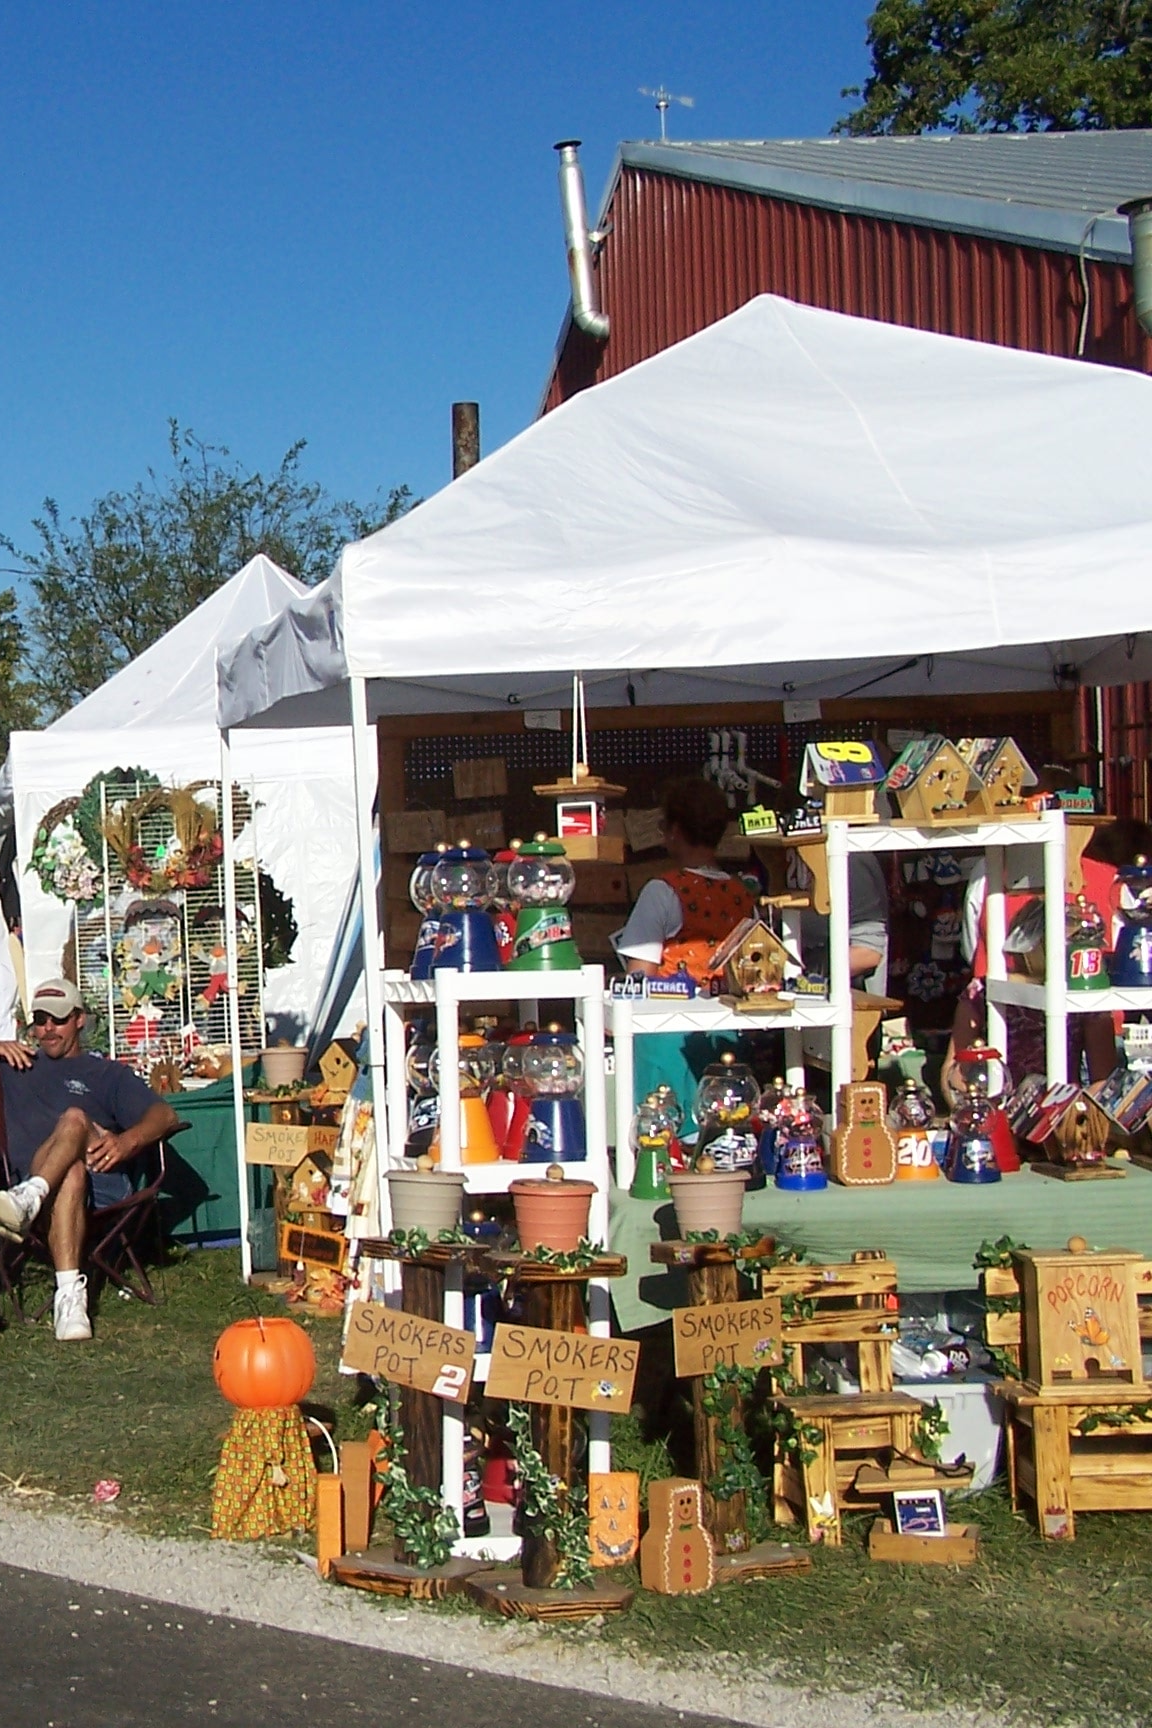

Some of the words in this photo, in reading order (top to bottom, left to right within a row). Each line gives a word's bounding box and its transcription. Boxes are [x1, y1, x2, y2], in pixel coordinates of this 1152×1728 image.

[1070, 948, 1103, 977] 18
[897, 1136, 932, 1167] 20
[1047, 1272, 1125, 1315] POPCORN
[355, 1308, 466, 1355] SMOKERS
[680, 1306, 774, 1341] SMOKERS
[373, 1345, 419, 1382] POT
[502, 1329, 637, 1373] SMOKERS
[702, 1342, 740, 1369] POT
[432, 1363, 468, 1398] 2
[524, 1369, 585, 1401] POT
